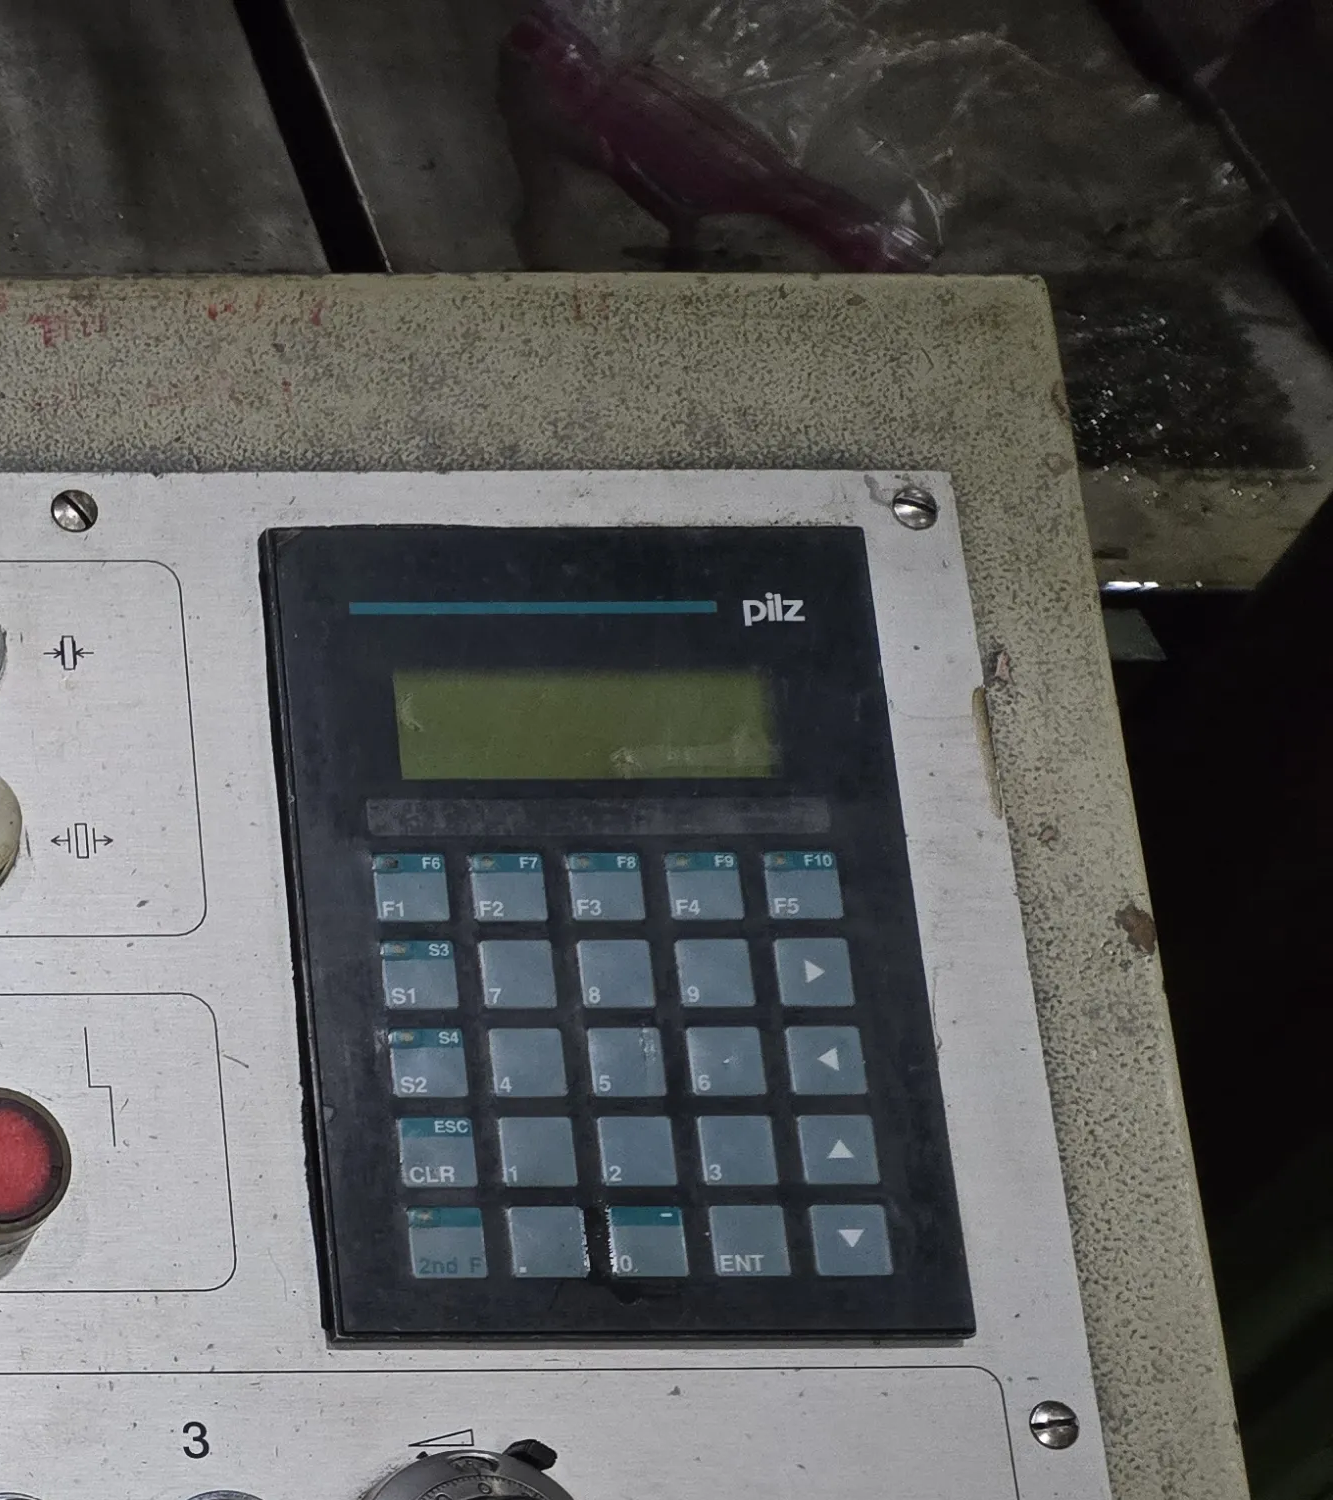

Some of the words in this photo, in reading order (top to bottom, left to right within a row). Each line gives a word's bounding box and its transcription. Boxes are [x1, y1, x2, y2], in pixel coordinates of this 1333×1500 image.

[743, 591, 806, 627] pilz
[422, 858, 441, 870] F6
[519, 858, 538, 869] F7
[617, 856, 637, 868] F8
[715, 856, 734, 868] F9
[804, 854, 833, 868] F10
[383, 902, 405, 918] F1
[479, 901, 503, 917] F2
[577, 900, 601, 916] F3
[675, 900, 700, 916] F4
[774, 898, 799, 914] F5
[429, 944, 449, 956] S3
[392, 988, 416, 1004] S1
[489, 988, 501, 1004] 7
[589, 988, 601, 1004] 8
[687, 986, 699, 1002] 9
[439, 1032, 459, 1044] S4
[401, 1077, 427, 1093] S2
[499, 1076, 511, 1092] 4
[599, 1076, 611, 1092] 5
[698, 1076, 711, 1092] 6
[434, 1120, 469, 1134] ESC
[409, 1167, 455, 1183] CLR
[509, 1168, 517, 1182] 1
[609, 1166, 621, 1182] 2
[709, 1165, 721, 1180] 3
[419, 1256, 459, 1274] 2nd
[470, 1258, 483, 1274] F
[721, 1255, 763, 1272] ENT
[182, 1421, 209, 1458] 3
